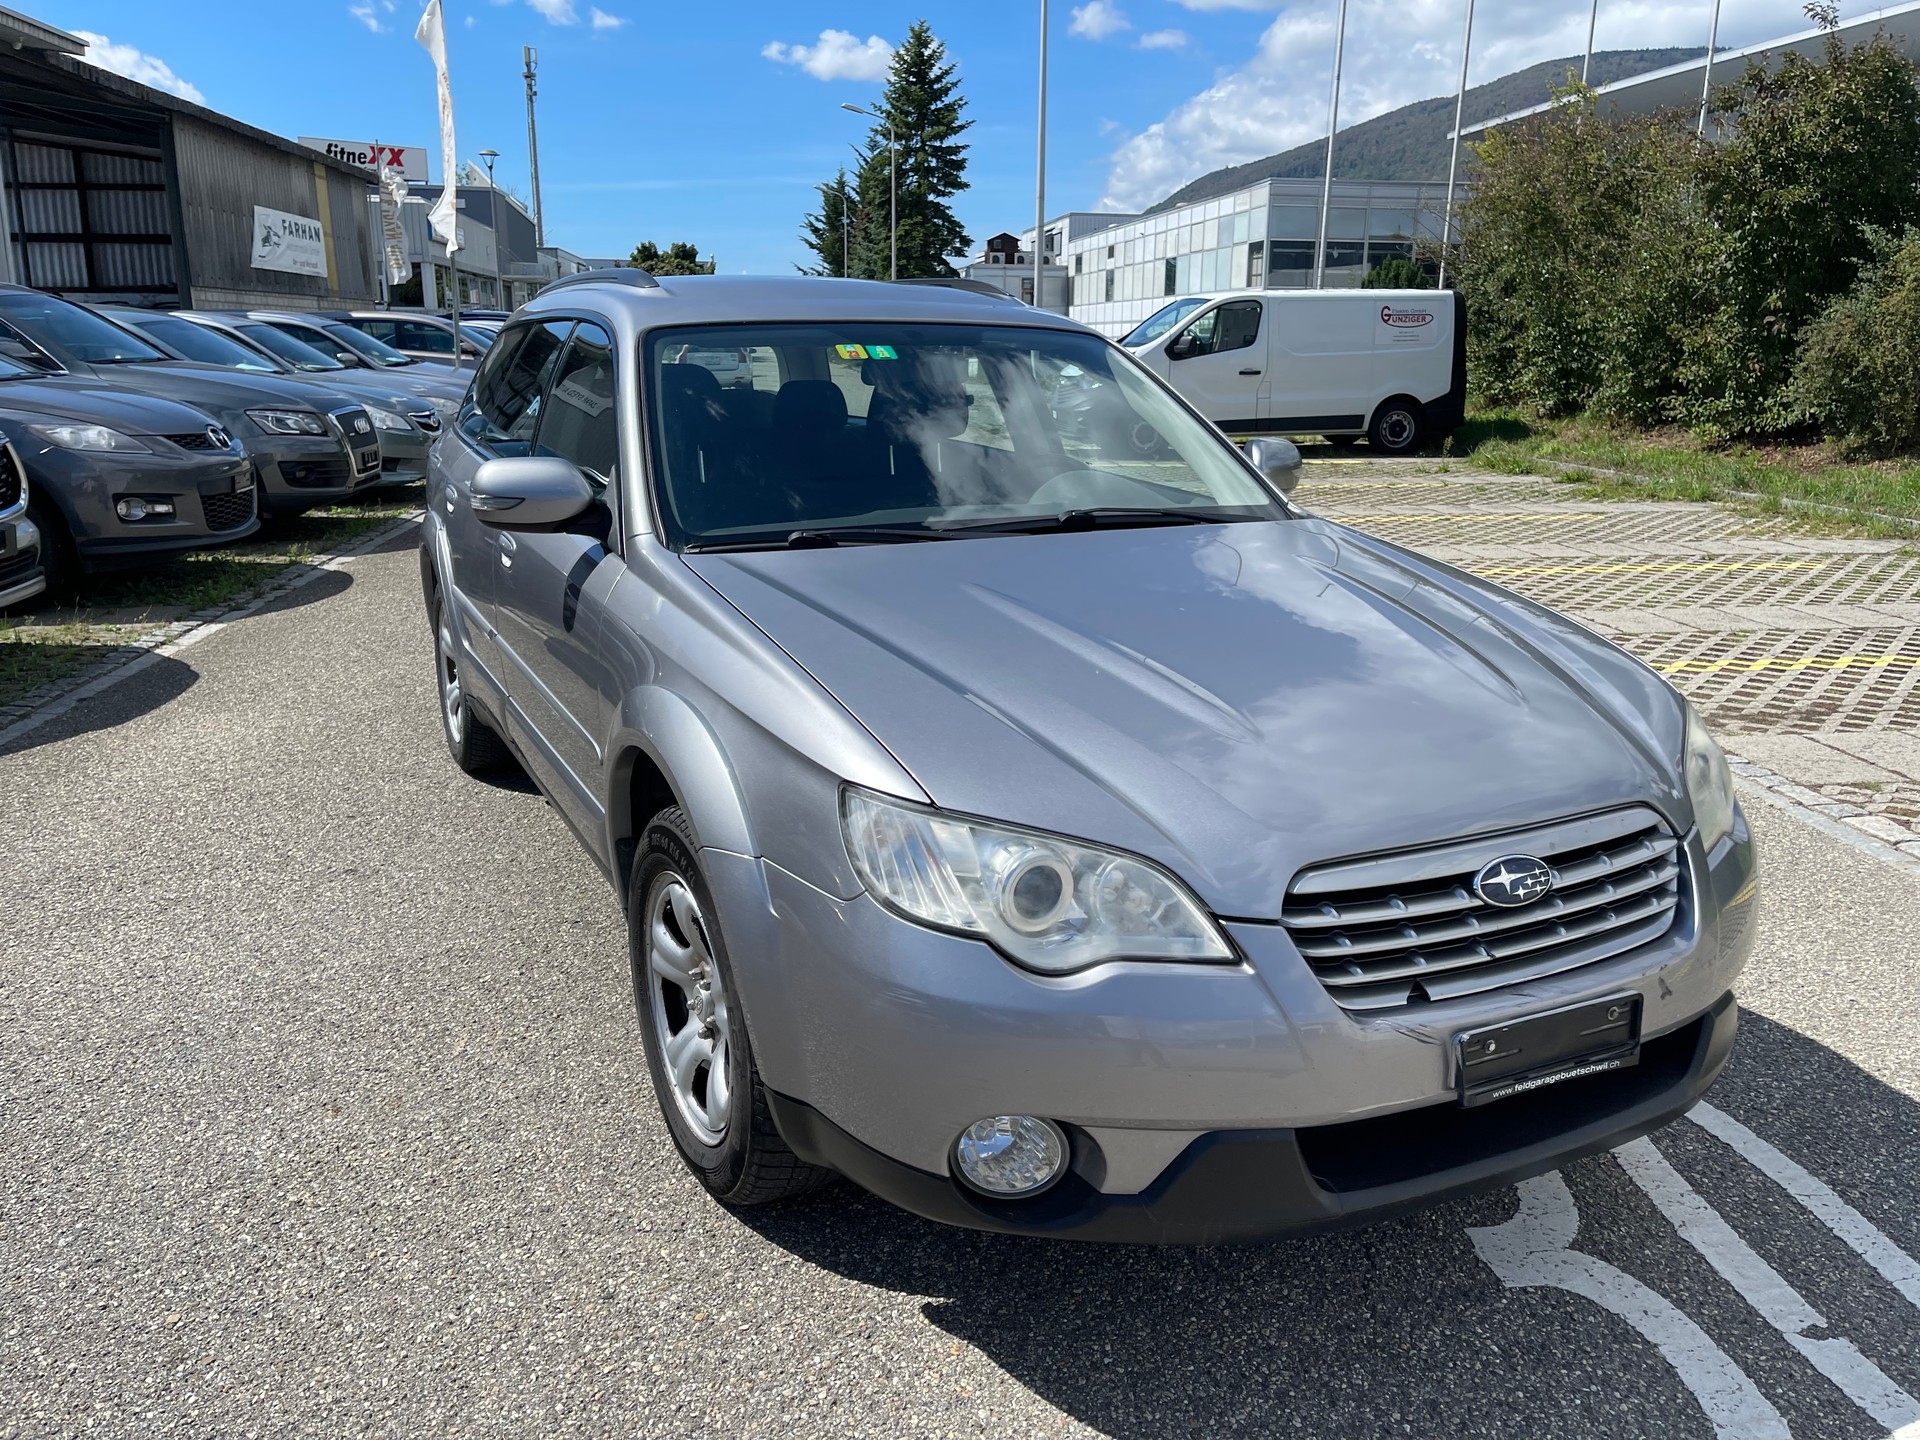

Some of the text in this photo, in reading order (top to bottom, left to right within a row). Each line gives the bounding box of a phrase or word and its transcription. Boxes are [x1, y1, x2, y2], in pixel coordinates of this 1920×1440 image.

[281, 219, 321, 243] FARHAN
[1381, 305, 1427, 324] GUNZIGER
[1492, 1060, 1620, 1099] www.feldgaragebuetschwil.ch
